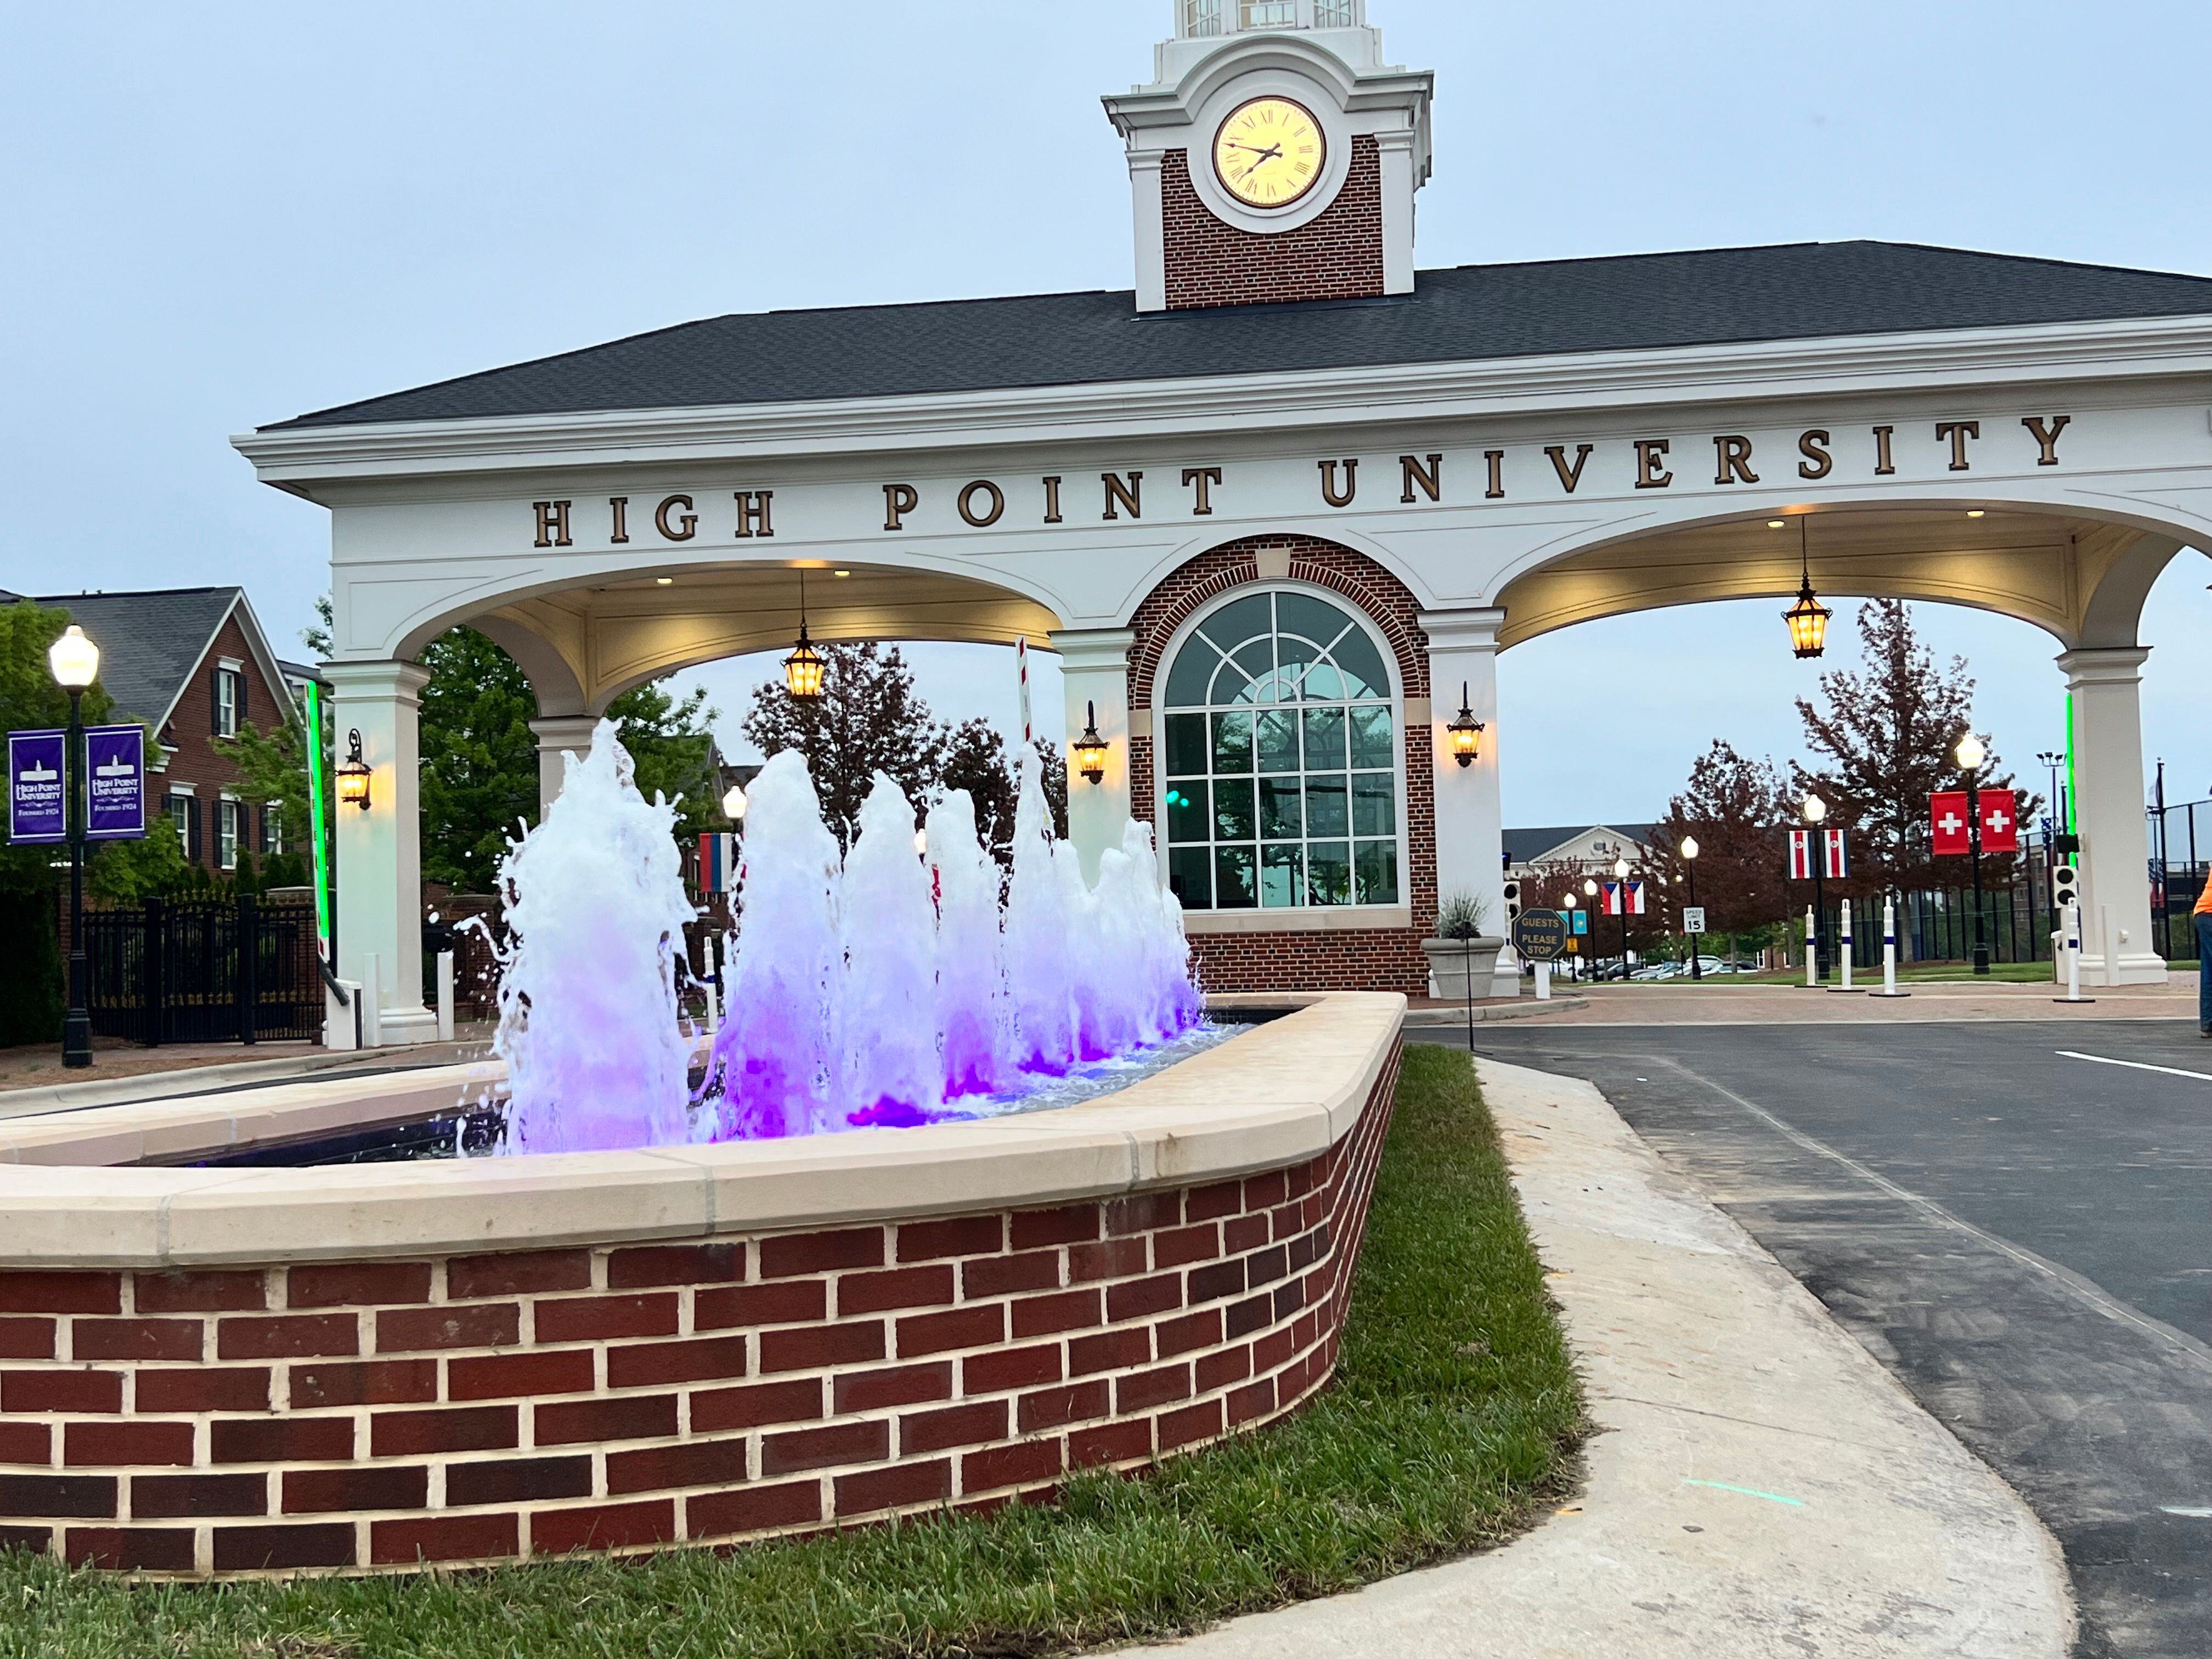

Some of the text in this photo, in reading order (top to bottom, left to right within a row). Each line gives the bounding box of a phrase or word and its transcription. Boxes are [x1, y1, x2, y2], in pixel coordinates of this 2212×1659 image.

[533, 415, 2070, 548] HIGH POINT UNIVERSITY
[92, 778, 138, 787] HIGH POINT
[38, 783, 61, 792] POINT
[93, 787, 138, 796] UNIVERSITY
[16, 792, 61, 800] UNIVERSITY
[1522, 918, 1559, 928] GUESTS
[1689, 921, 1701, 930] 15
[1522, 934, 1558, 945] PLEASE
[1527, 945, 1551, 954] STOP
